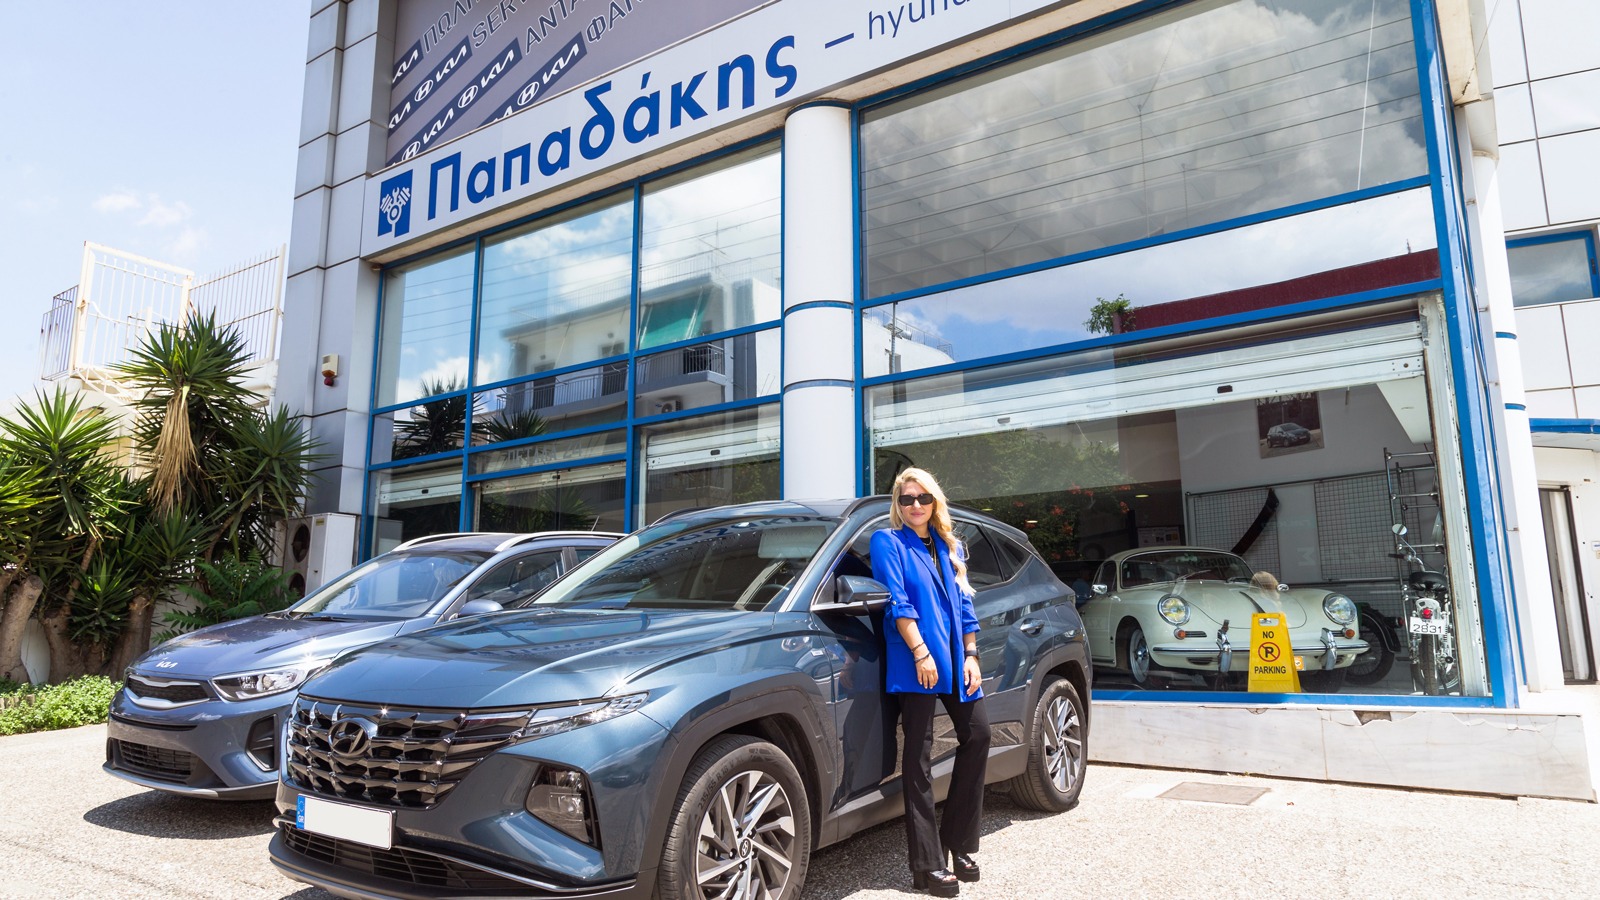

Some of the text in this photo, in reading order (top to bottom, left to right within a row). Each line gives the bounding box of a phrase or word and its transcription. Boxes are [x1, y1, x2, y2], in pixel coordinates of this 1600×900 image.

[472, 0, 527, 48] SER
[427, 35, 798, 220] Παπαδάκης
[563, 439, 583, 459] 24
[1262, 630, 1275, 639] NO
[1413, 623, 1442, 634] 2831
[1254, 665, 1287, 675] PARKING
